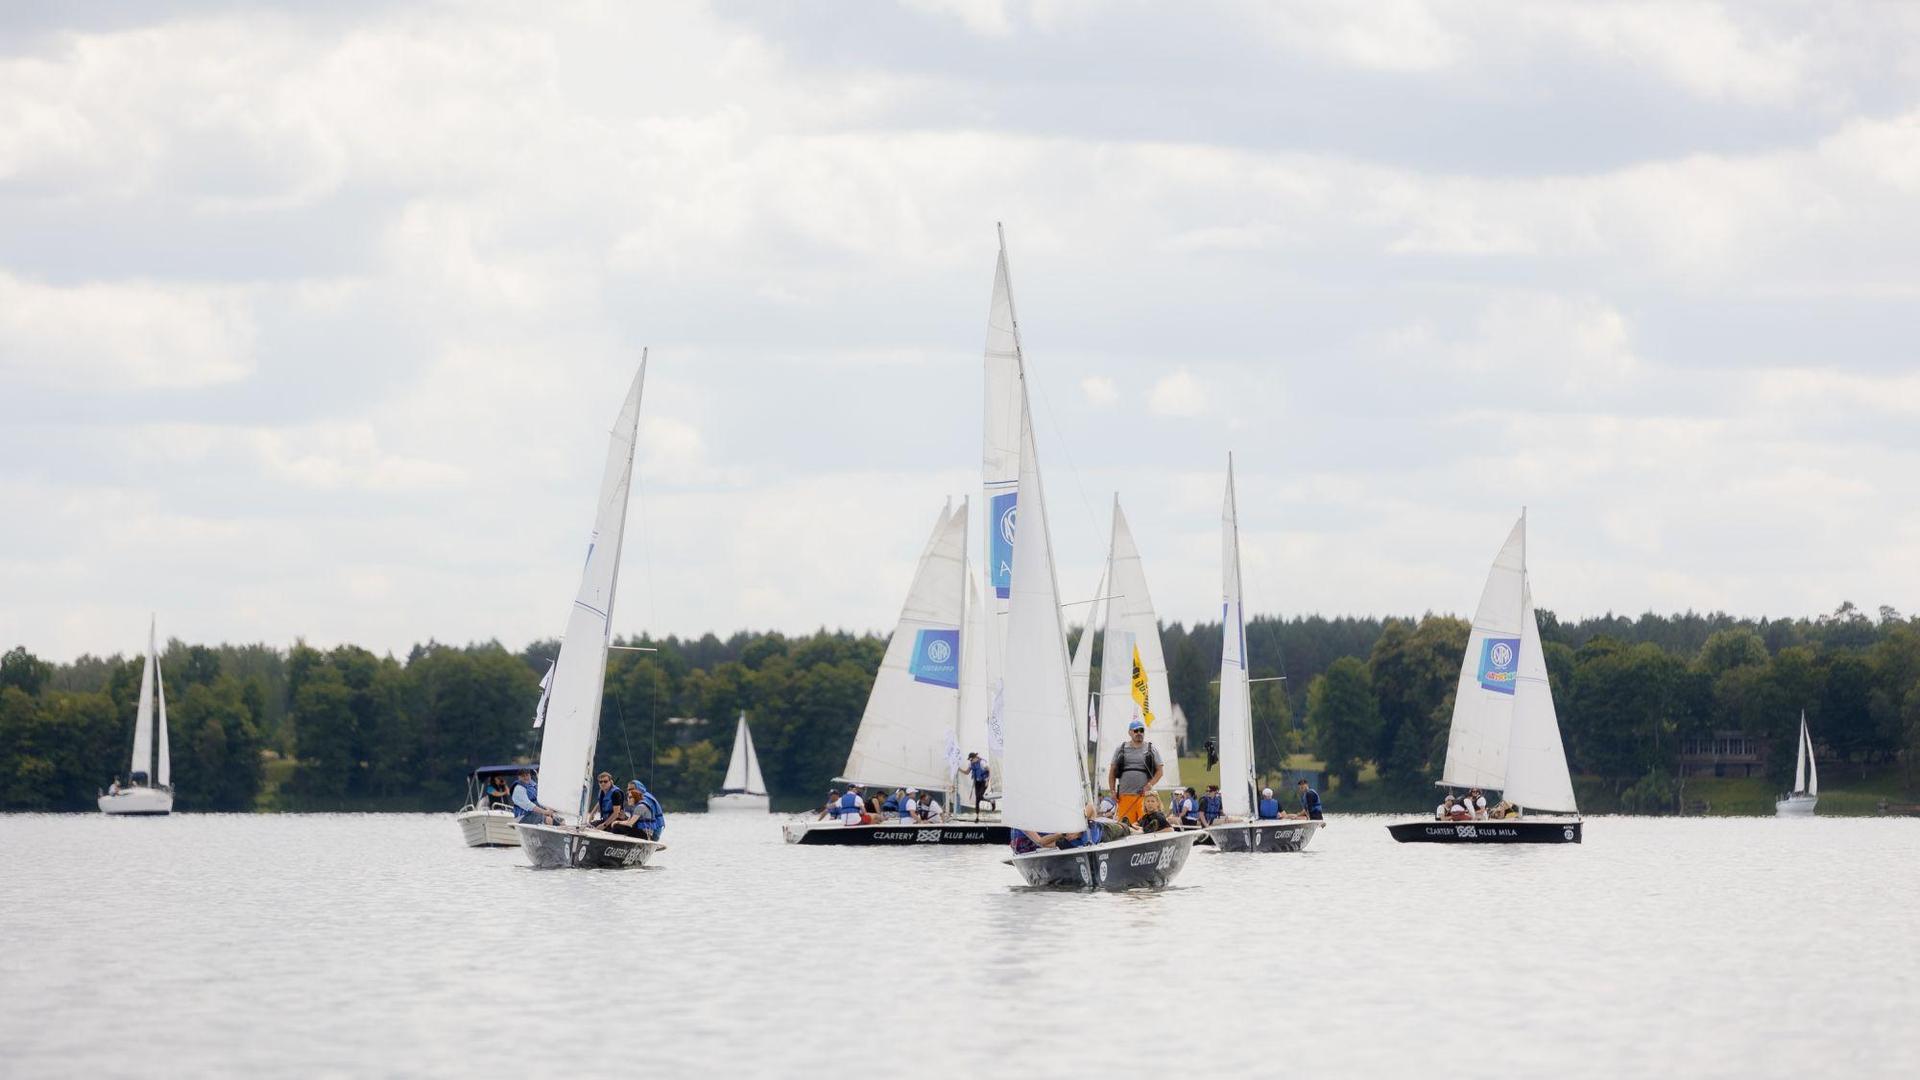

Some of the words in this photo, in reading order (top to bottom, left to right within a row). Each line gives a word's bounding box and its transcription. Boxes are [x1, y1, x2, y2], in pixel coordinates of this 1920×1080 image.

[873, 831, 914, 840] CZARTERY
[943, 831, 964, 840] KLUB
[964, 832, 985, 840] MILA
[1130, 851, 1160, 867] CZARTERY
